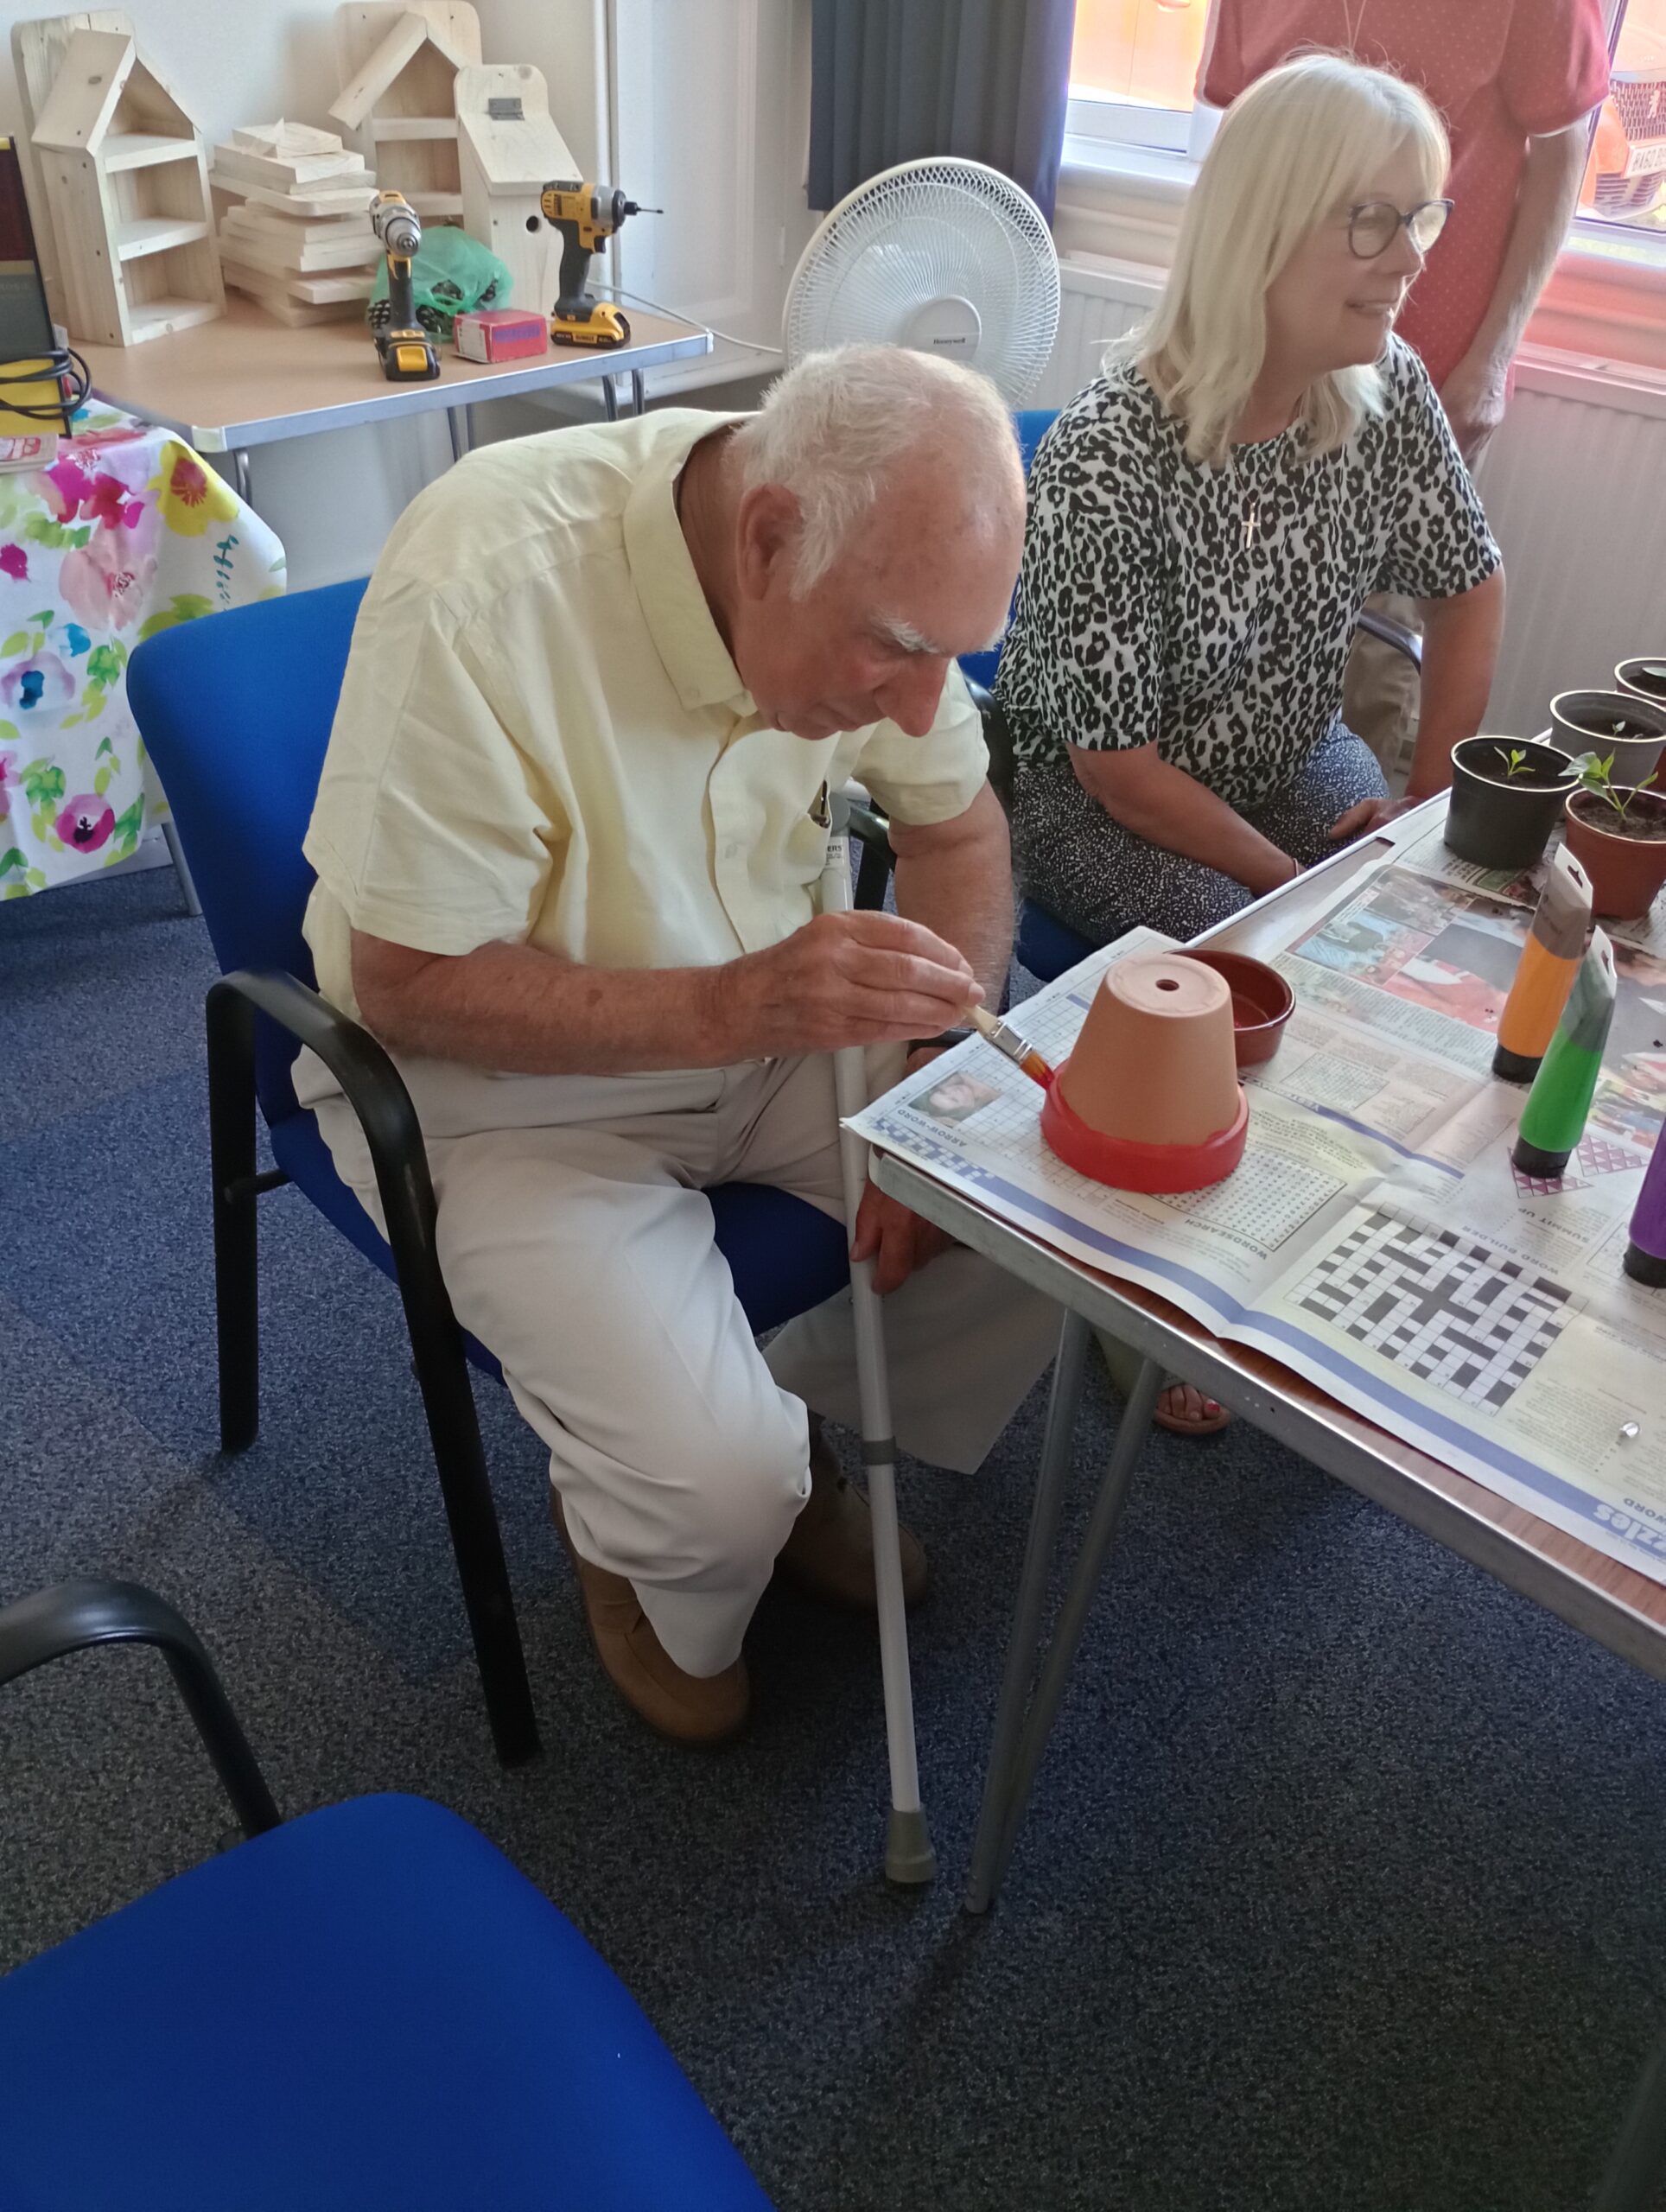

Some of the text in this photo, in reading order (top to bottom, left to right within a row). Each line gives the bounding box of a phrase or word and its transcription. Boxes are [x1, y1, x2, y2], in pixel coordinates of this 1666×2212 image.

[933, 337, 966, 346] Honeywell
[898, 1109, 968, 1147] ARROW-WORD
[1518, 1207, 1536, 1218] UP
[1185, 1219, 1268, 1260] WORDSEARCH
[1462, 1225, 1518, 1254] BUILDER
[1539, 1217, 1591, 1243] SUMMIT
[1521, 1254, 1559, 1275] WORD
